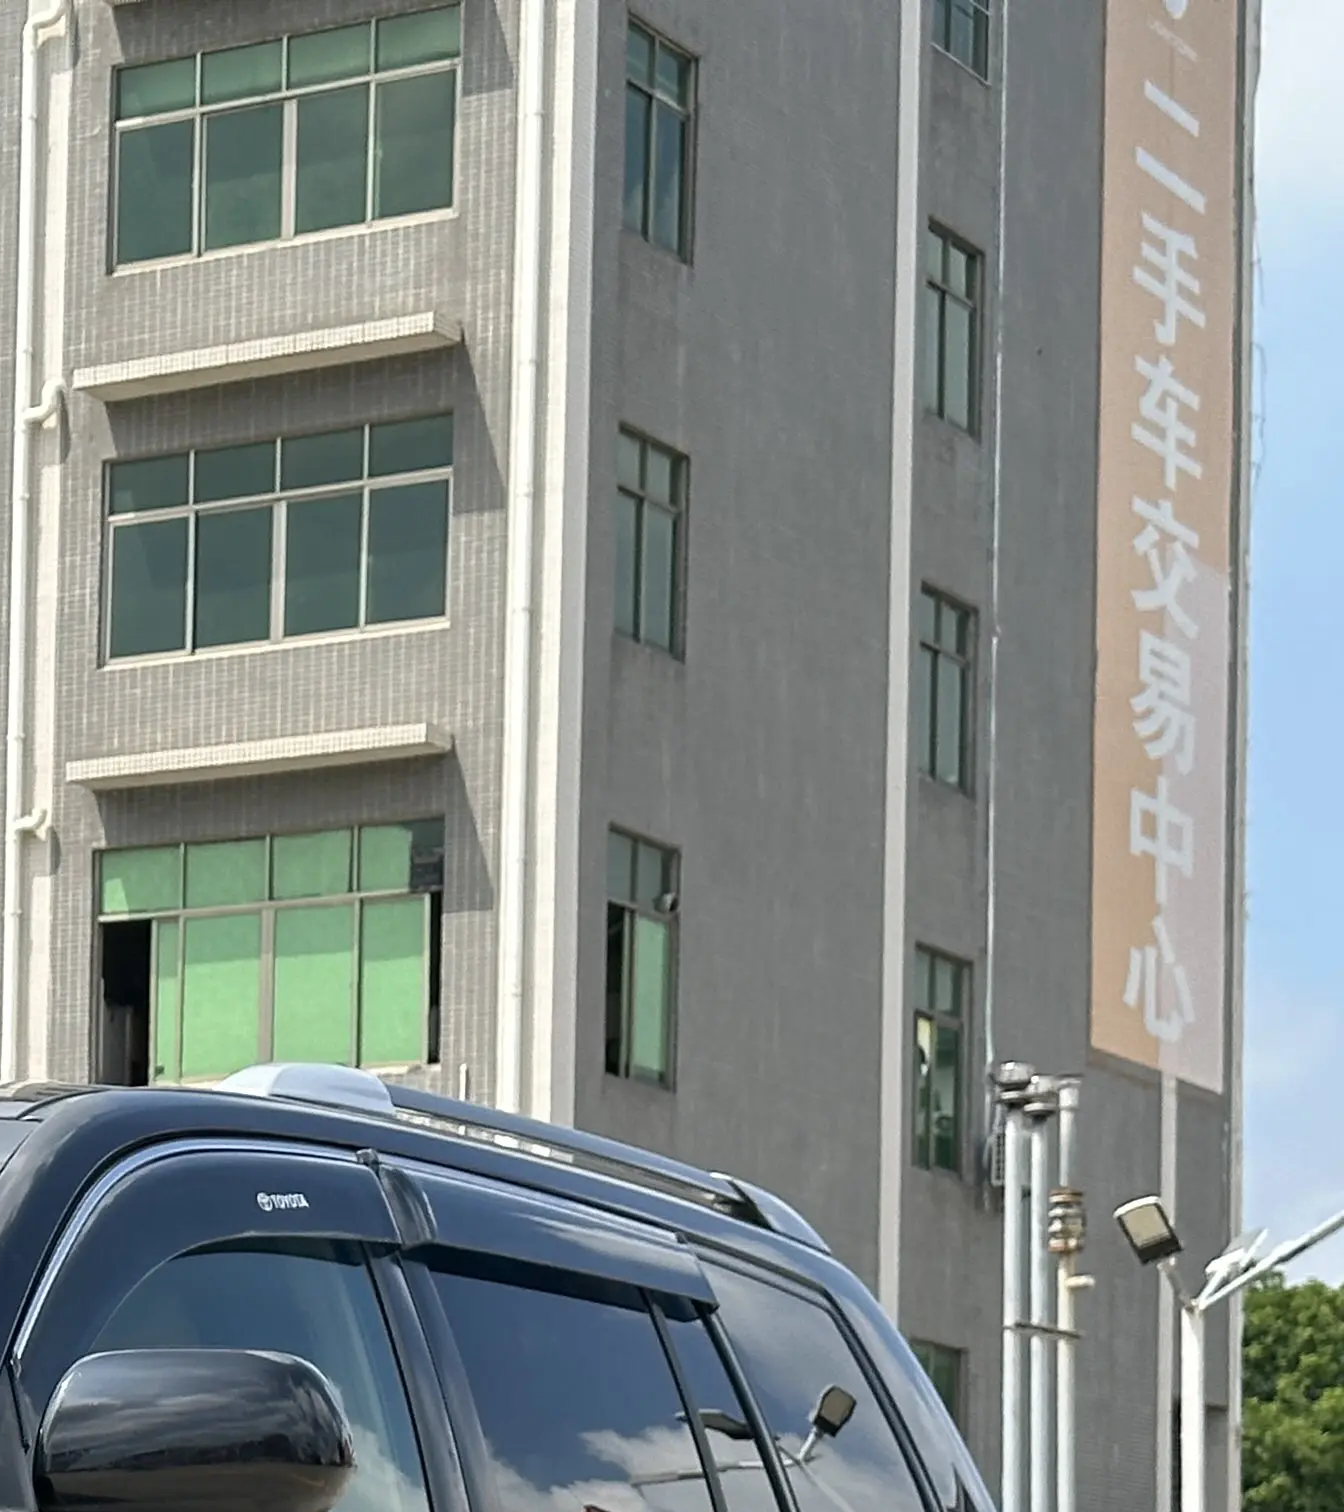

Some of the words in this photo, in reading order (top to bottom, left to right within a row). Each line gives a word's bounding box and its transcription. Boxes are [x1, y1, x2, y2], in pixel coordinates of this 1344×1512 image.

[1123, 78, 1206, 1043] 二手车交易中心
[270, 1193, 310, 1209] TOYOTA
